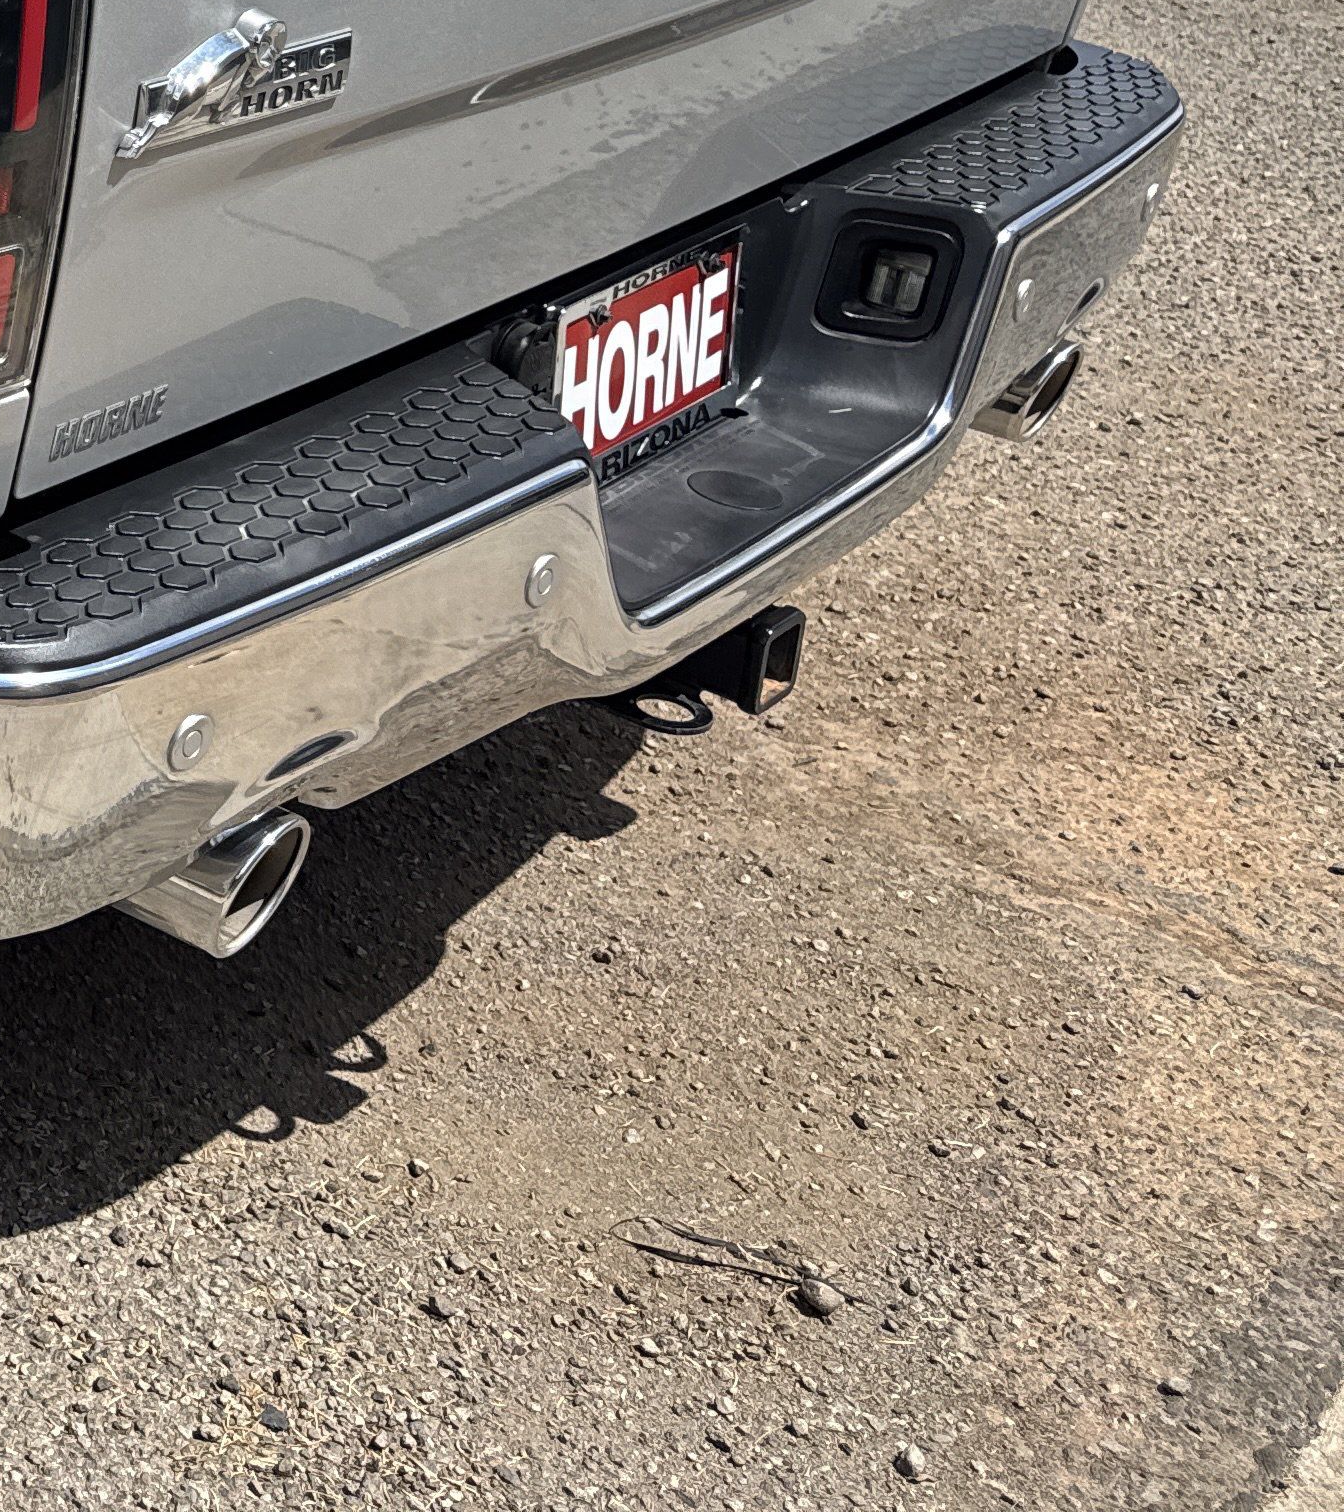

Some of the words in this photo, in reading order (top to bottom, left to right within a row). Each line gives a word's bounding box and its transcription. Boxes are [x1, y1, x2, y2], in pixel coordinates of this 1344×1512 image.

[240, 70, 344, 117] HORN
[274, 44, 336, 83] BIG
[561, 267, 729, 450] HORNE
[48, 383, 169, 462] HORNE
[600, 403, 712, 482] RIZONA
